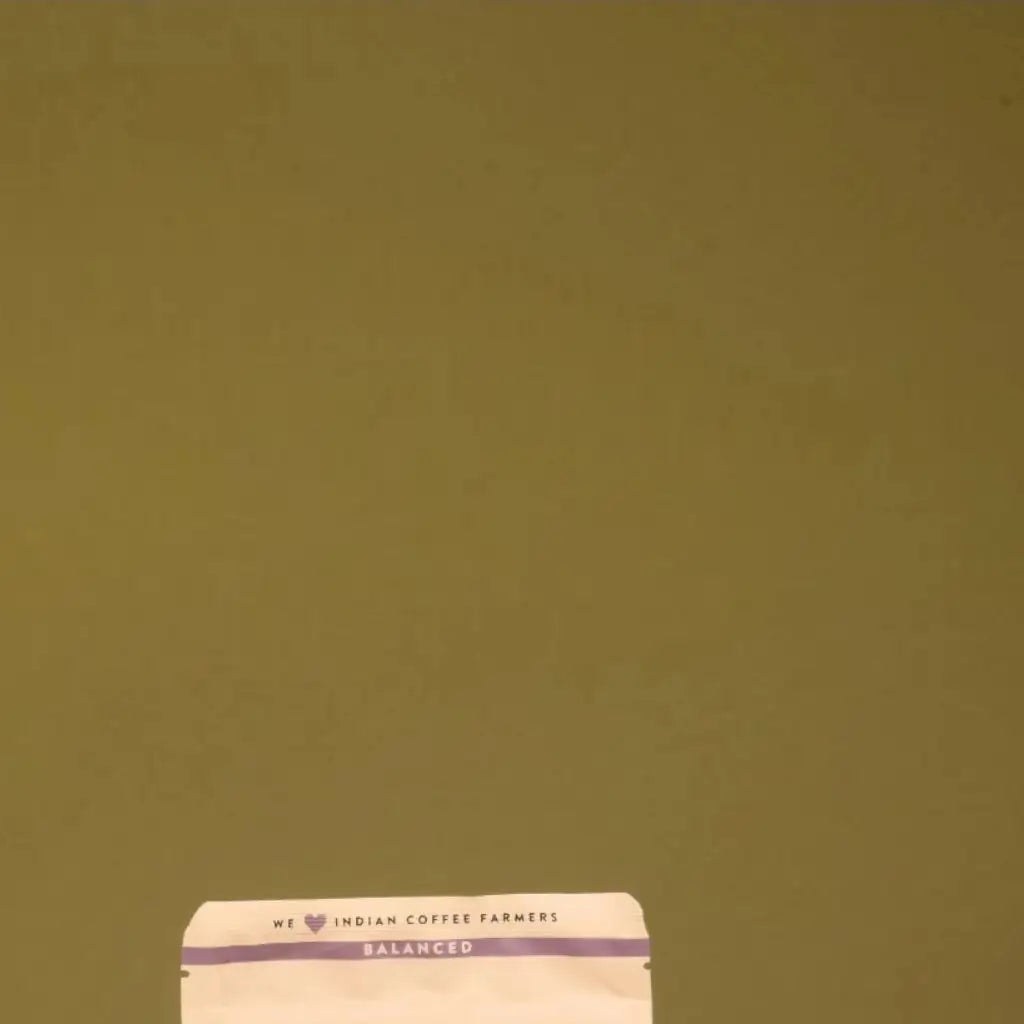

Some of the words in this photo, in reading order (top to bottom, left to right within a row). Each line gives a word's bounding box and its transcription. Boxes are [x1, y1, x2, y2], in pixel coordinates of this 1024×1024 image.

[273, 918, 295, 929] WE
[334, 915, 397, 927] INDIAN
[406, 913, 471, 925] COFFEE
[480, 911, 559, 924] FARMERS
[363, 941, 474, 957] BALANCED
